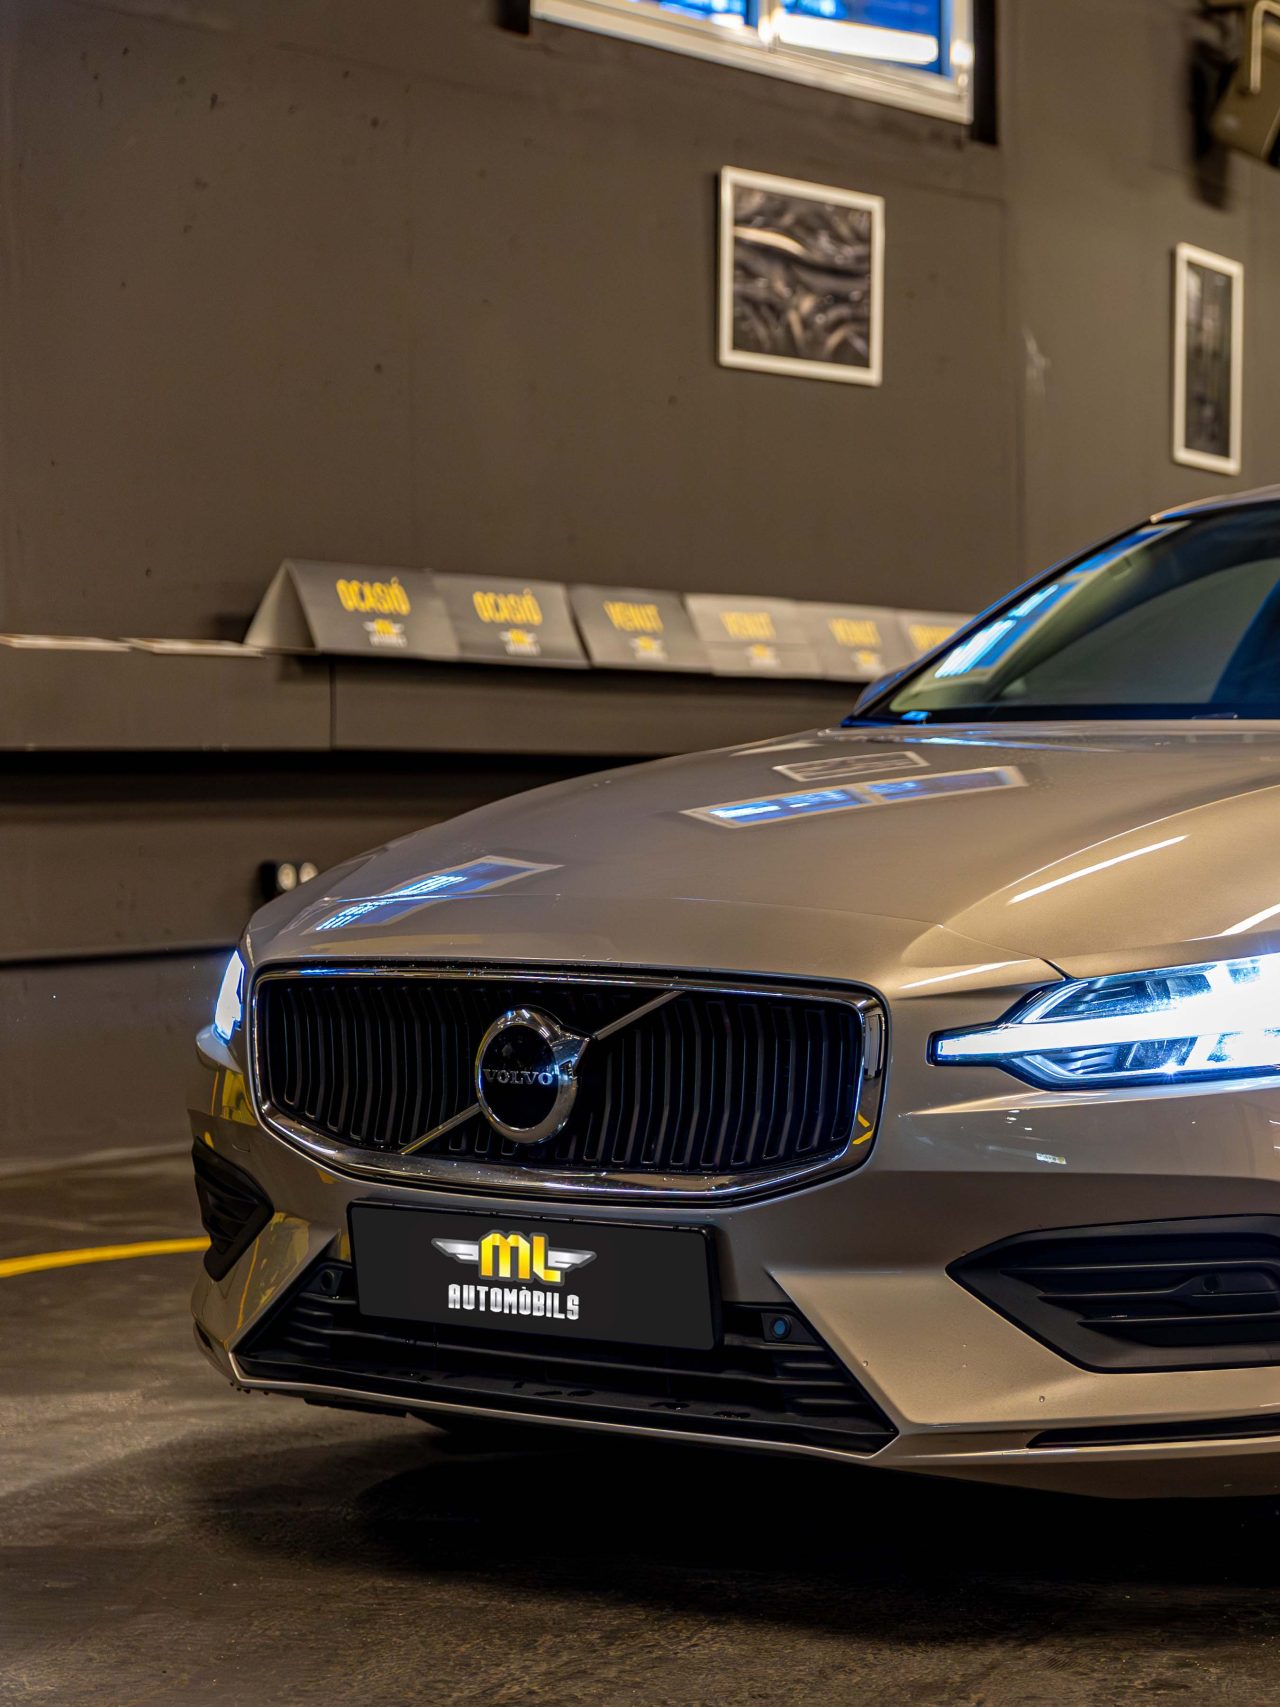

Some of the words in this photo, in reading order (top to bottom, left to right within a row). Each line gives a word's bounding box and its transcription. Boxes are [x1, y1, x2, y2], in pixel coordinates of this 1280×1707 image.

[336, 577, 411, 615] OCASIÓ
[482, 1068, 554, 1086] VOLVO
[481, 1232, 561, 1283] ML
